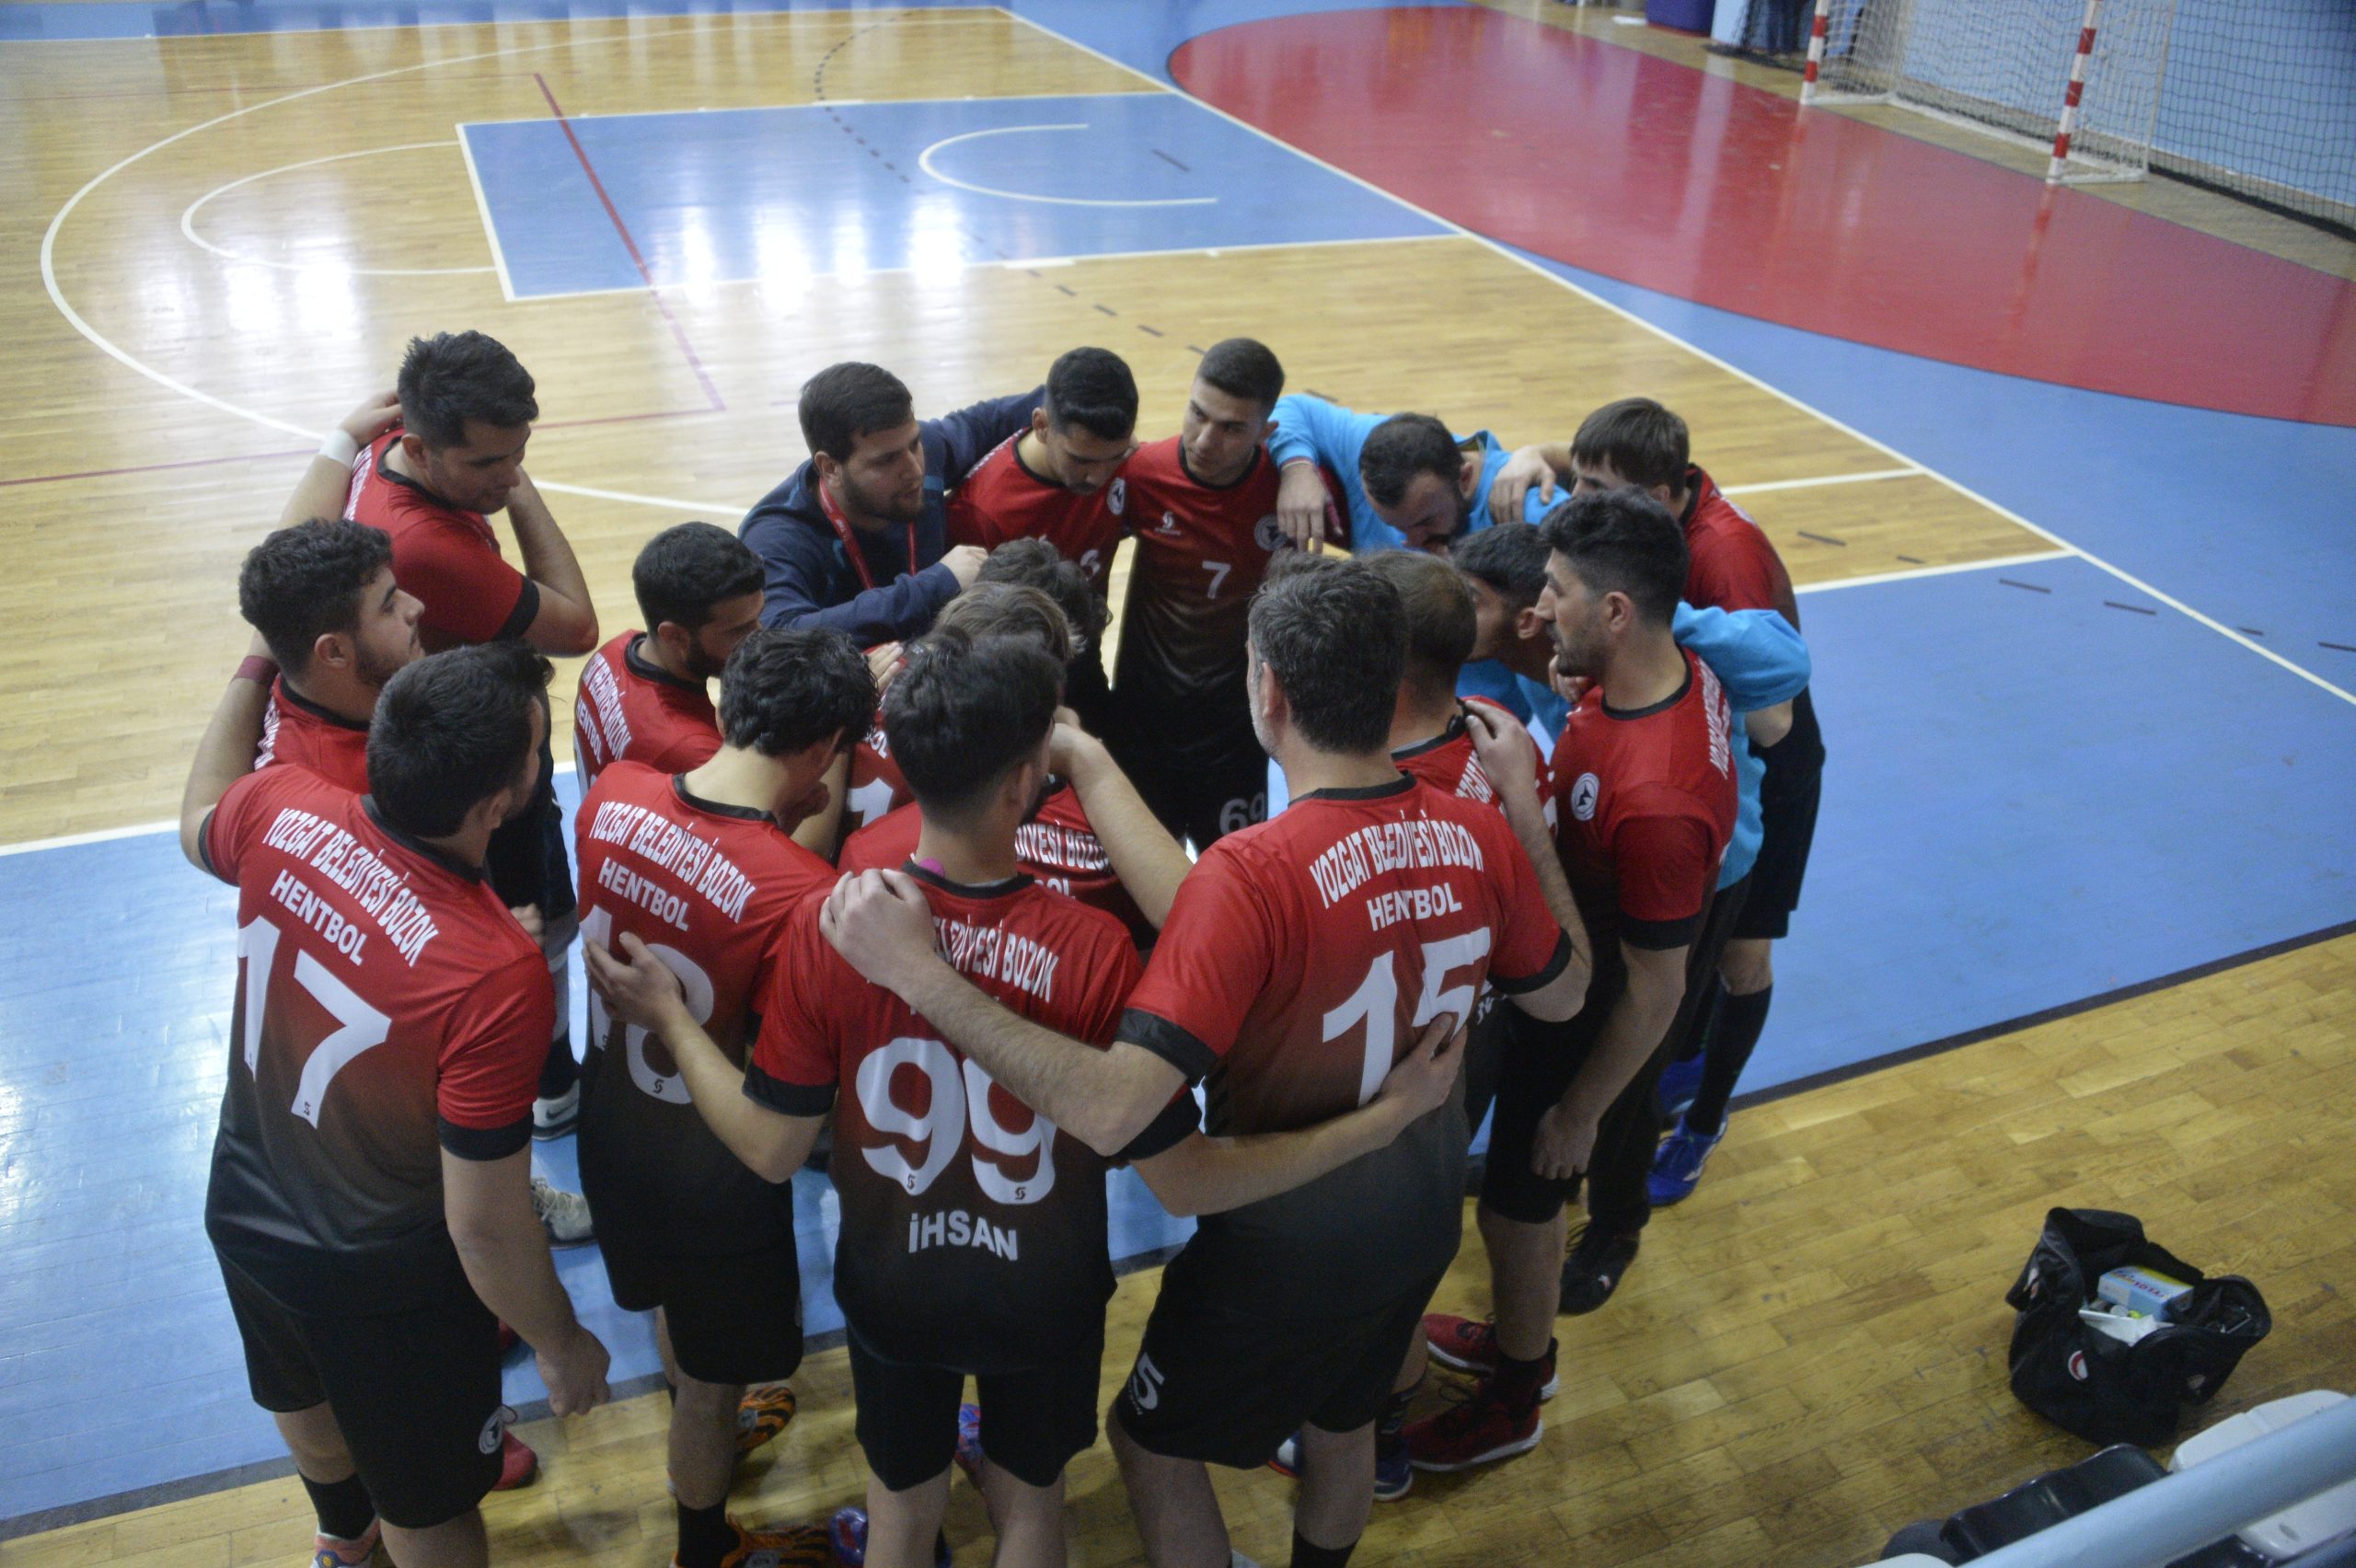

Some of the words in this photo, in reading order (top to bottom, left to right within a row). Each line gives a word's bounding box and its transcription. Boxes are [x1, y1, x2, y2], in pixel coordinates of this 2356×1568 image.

[1201, 559, 1231, 599] 7
[261, 807, 338, 860] YOZGAT
[309, 828, 411, 917] BELEDİYESİ
[376, 887, 439, 968] BOZOK
[588, 801, 648, 847] YOZGAT
[628, 812, 719, 886] BELEDİYESİ
[696, 852, 756, 924] BOZOK
[598, 856, 689, 932] HENTBOL
[1309, 831, 1372, 910] YOZGAT
[270, 869, 367, 966] HENTBOL
[1366, 882, 1463, 932] HENTBOL
[1000, 931, 1060, 1004] BOZOK
[237, 915, 393, 1130] 17
[1322, 926, 1492, 1108] 15
[855, 1036, 1058, 1205] 99
[907, 1209, 1019, 1262] İHSAN
